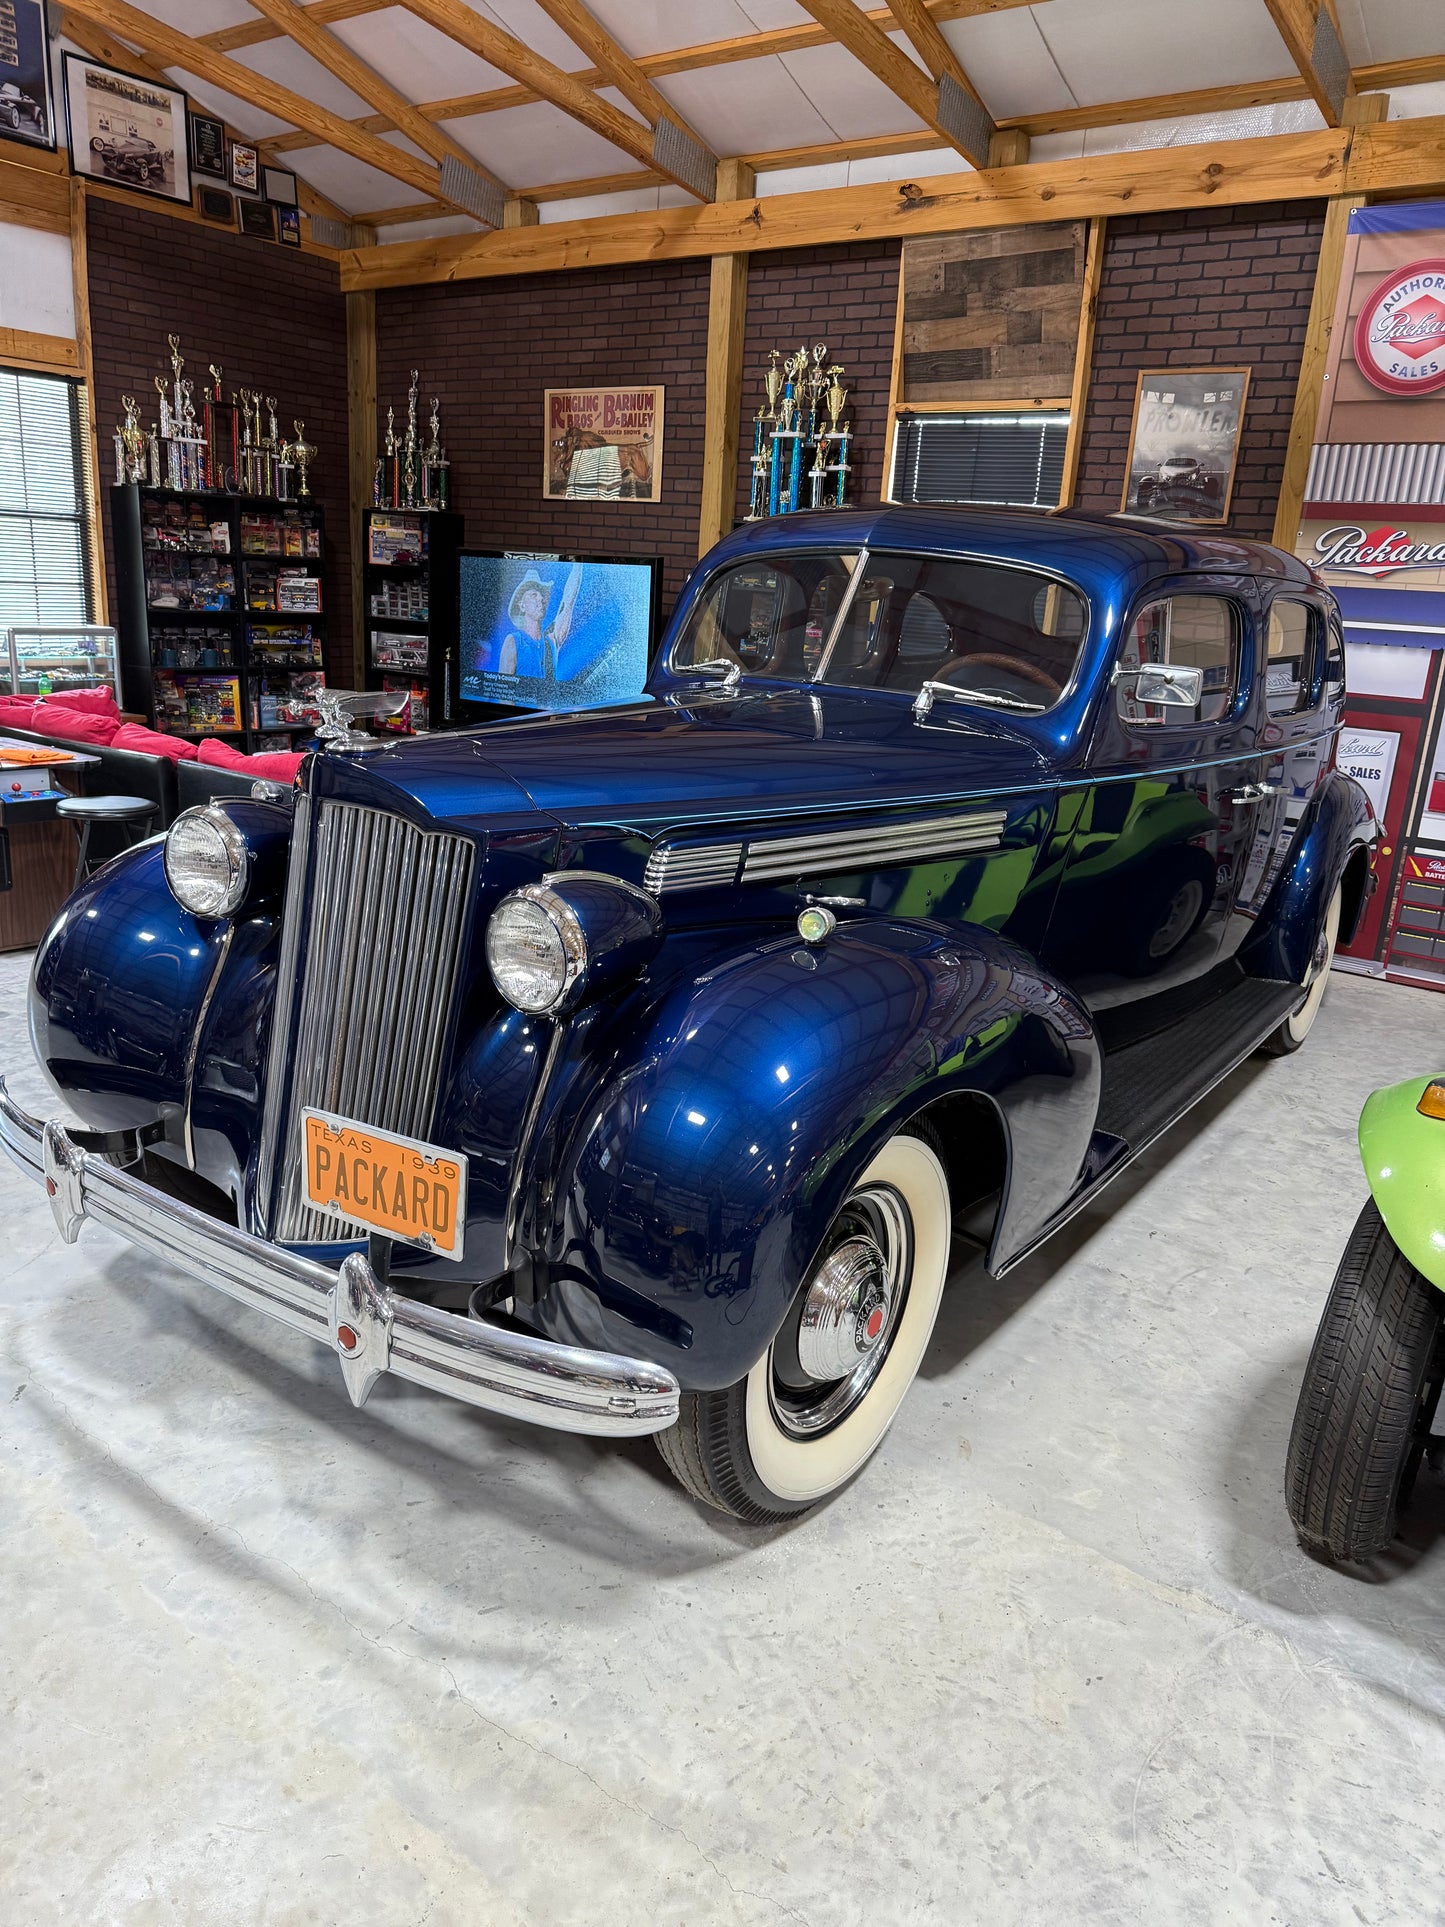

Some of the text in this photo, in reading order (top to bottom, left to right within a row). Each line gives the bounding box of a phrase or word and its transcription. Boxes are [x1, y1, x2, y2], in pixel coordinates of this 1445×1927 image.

[1383, 276, 1445, 313] AUTHOR
[1389, 361, 1439, 378] SALES
[551, 393, 654, 429] RINGLING BARNUM
[567, 413, 593, 429] BROS
[615, 417, 621, 426] &
[621, 412, 654, 428] BAILEY
[1143, 405, 1234, 434] PROWLER
[1349, 765, 1382, 780] SALES
[310, 1123, 373, 1154] TEXAS
[401, 1153, 456, 1180] 1939
[315, 1144, 450, 1233] PACKARD
[856, 1293, 881, 1344] PACKARD
